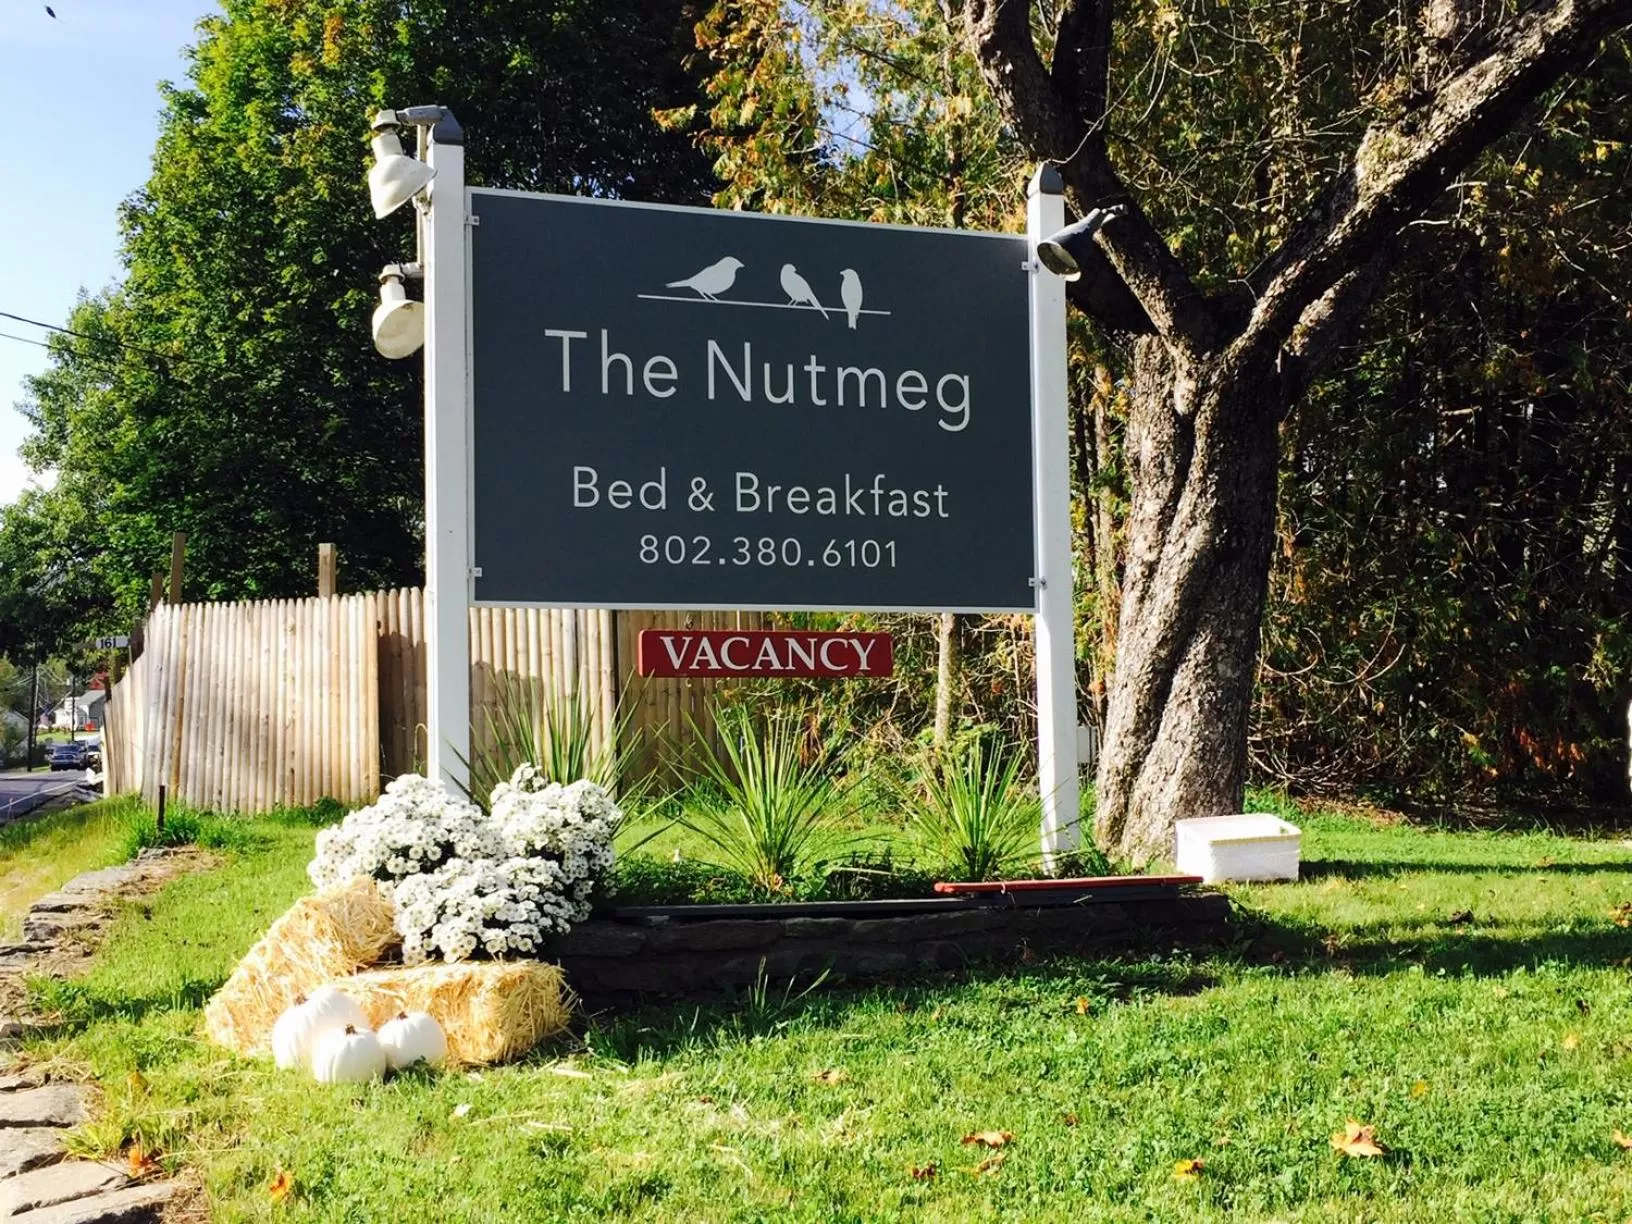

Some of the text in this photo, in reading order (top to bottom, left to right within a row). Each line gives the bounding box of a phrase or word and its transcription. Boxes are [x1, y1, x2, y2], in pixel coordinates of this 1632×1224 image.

[544, 328, 971, 432] The Nutmeg
[573, 466, 950, 519] Bed & Breakfast
[639, 534, 898, 568] 802.380.6101
[101, 638, 116, 649] 161
[659, 635, 876, 671] VACANCY
